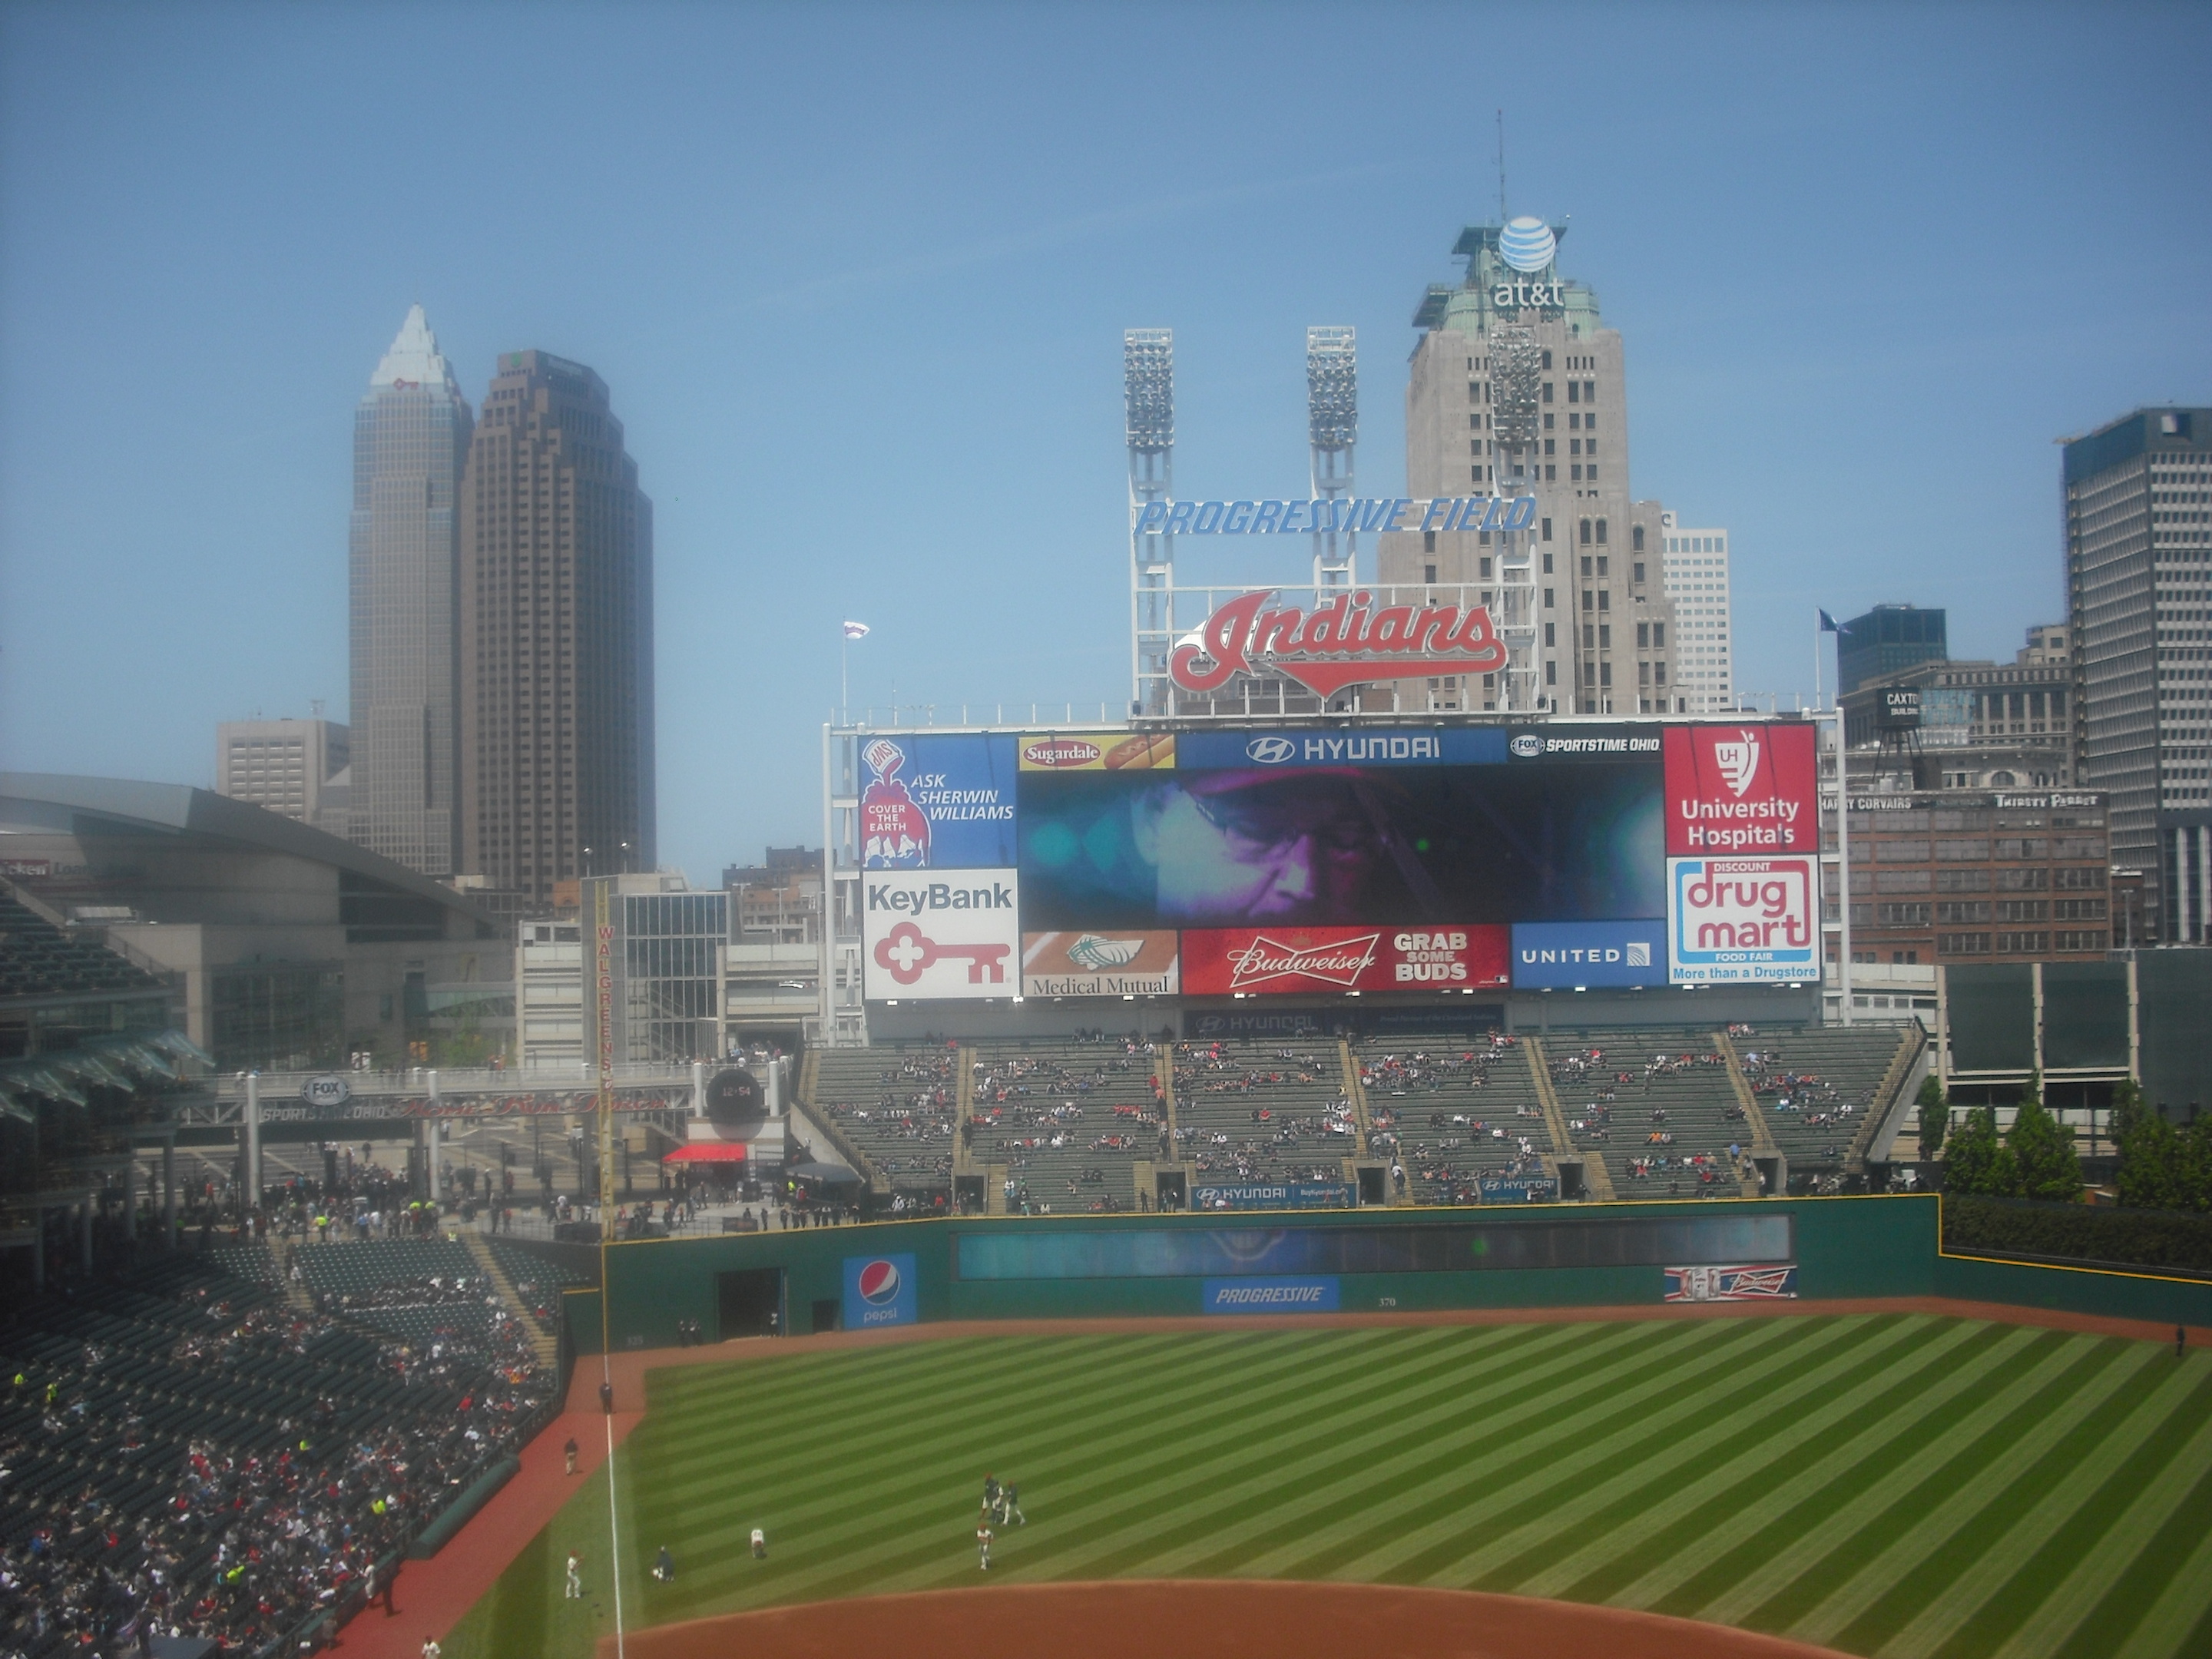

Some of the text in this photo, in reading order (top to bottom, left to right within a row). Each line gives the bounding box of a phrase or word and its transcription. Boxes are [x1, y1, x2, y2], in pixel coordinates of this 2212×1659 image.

[1495, 277, 1564, 306] at&t
[1133, 496, 1536, 535] PROGRESSIVE FIELD
[1169, 588, 1508, 694] Indians
[1304, 737, 1440, 760] HYUNDAI
[1518, 739, 1538, 748] FOX
[1546, 738, 1660, 752] SPORTSTIME OHIO
[871, 742, 893, 767] SWP
[1027, 745, 1098, 764] Sugardale
[1720, 749, 1738, 762] UH
[911, 774, 946, 788] ASK
[918, 790, 998, 804] SHERWIN
[1821, 797, 1912, 810] HARY CORVAIRS
[868, 805, 906, 814] COVER
[930, 806, 1014, 820] WILLIAMS
[1681, 796, 1799, 823] University
[869, 823, 906, 832] EARTH
[1688, 823, 1795, 850] Hospitals
[1, 862, 47, 876] cken
[1714, 862, 1771, 873] DISCOUNT
[869, 882, 1012, 916] KeyBank
[1687, 871, 1786, 918] drug
[1698, 915, 1803, 948] mart
[1394, 932, 1467, 951] GRAB
[1227, 949, 1375, 975] Budweiser
[1406, 951, 1455, 963] SOME
[1522, 949, 1621, 964] UNITED
[1715, 952, 1773, 962] FOOD FAIR
[1396, 963, 1467, 982] BUDS
[1673, 966, 1816, 979] More than a Drugstore
[1033, 975, 1168, 995] Medical Mutual
[598, 926, 614, 1071] WALGREENS
[1230, 1015, 1313, 1029] HYUNDAI
[313, 1081, 339, 1094] FOX
[262, 1106, 385, 1121] SPORTSE OHIO
[1224, 1187, 1286, 1199] HYUNDAI
[1216, 1286, 1323, 1304] PROGRESSIVE
[1379, 1298, 1396, 1307] 370
[864, 1307, 897, 1323] pepsi
